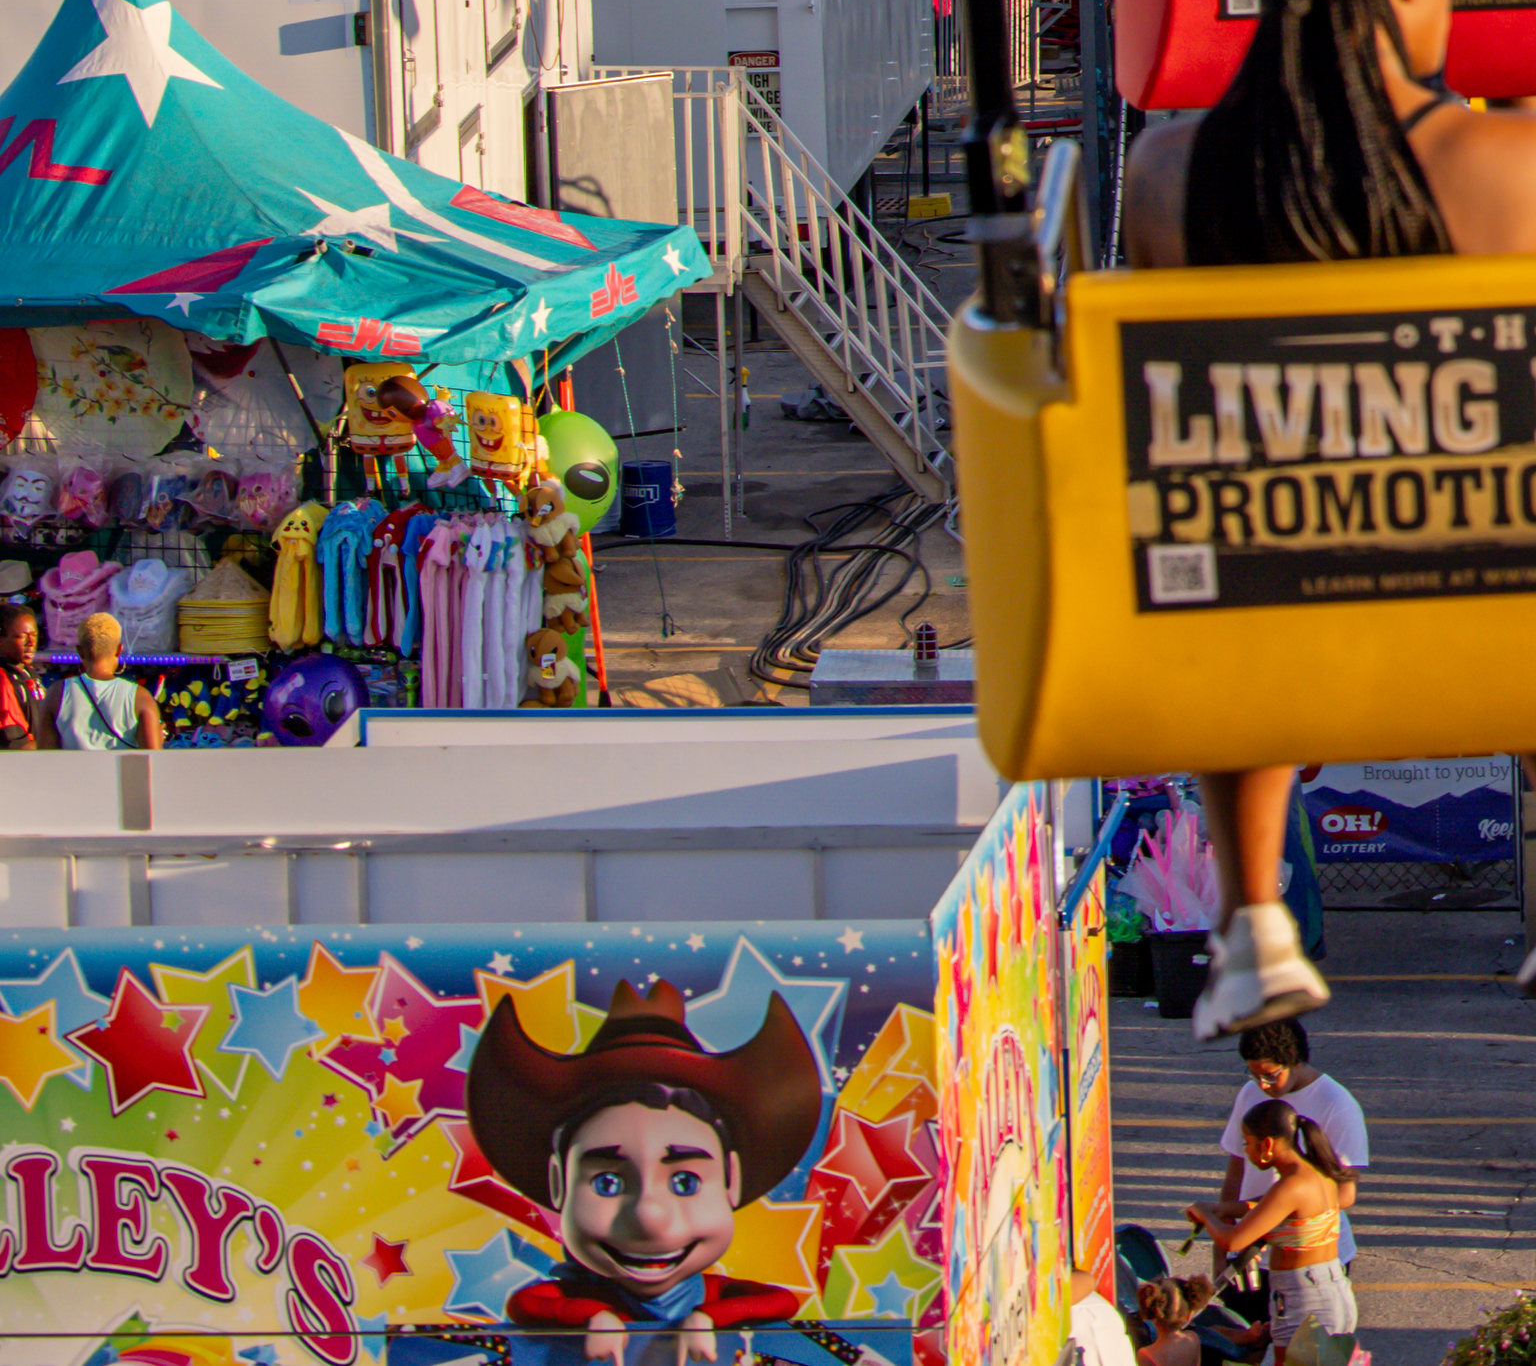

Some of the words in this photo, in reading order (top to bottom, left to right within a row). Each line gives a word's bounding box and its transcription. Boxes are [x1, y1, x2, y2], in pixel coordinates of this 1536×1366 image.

[734, 56, 776, 66] DANGER
[1144, 359, 1500, 467] LIVING
[1364, 765, 1430, 784] Brought
[1435, 766, 1451, 779] to
[1456, 765, 1485, 782] you
[1491, 762, 1509, 780] by
[1321, 811, 1382, 833] OH!
[1323, 843, 1386, 854] LOTTERY
